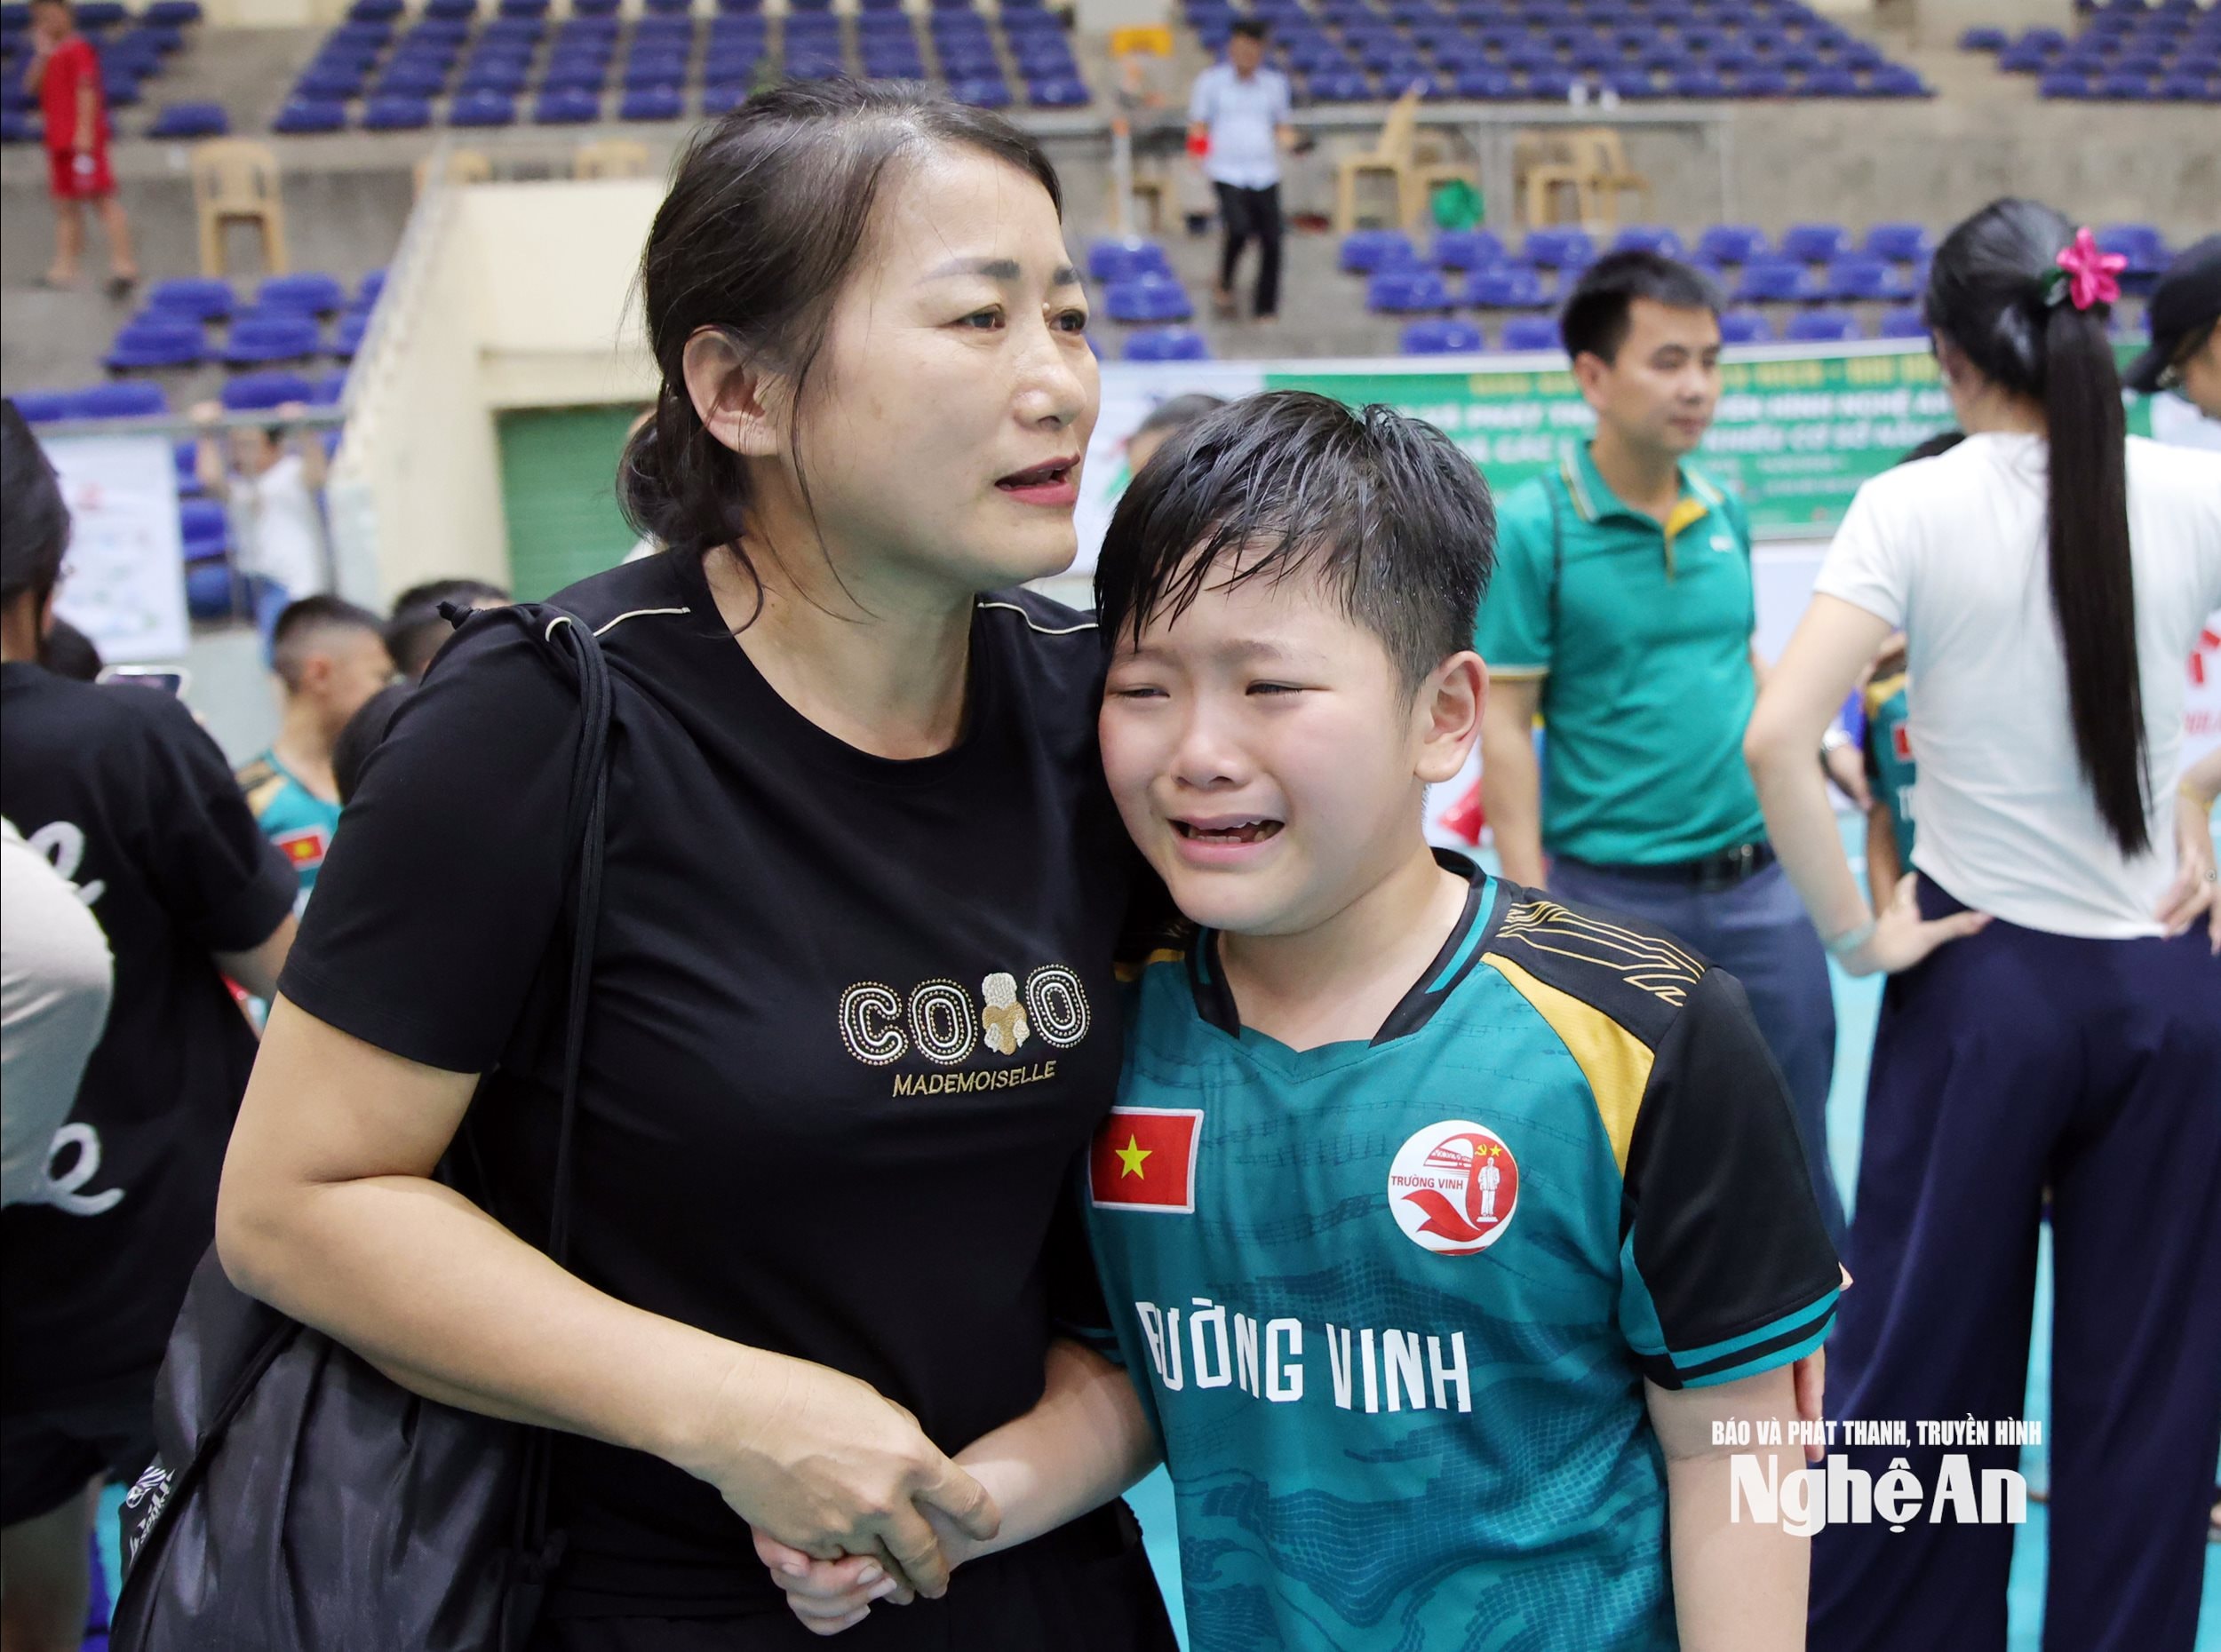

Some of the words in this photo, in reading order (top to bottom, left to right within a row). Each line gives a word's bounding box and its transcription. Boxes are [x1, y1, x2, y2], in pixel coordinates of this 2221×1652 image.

[892, 1060, 1057, 1097] MADEMOISELLE
[1391, 1173, 1435, 1188] TRƯỜNG
[1437, 1177, 1463, 1190] VINH
[1135, 1298, 1303, 1402] RƯỜNG
[1325, 1322, 1471, 1414] VINH
